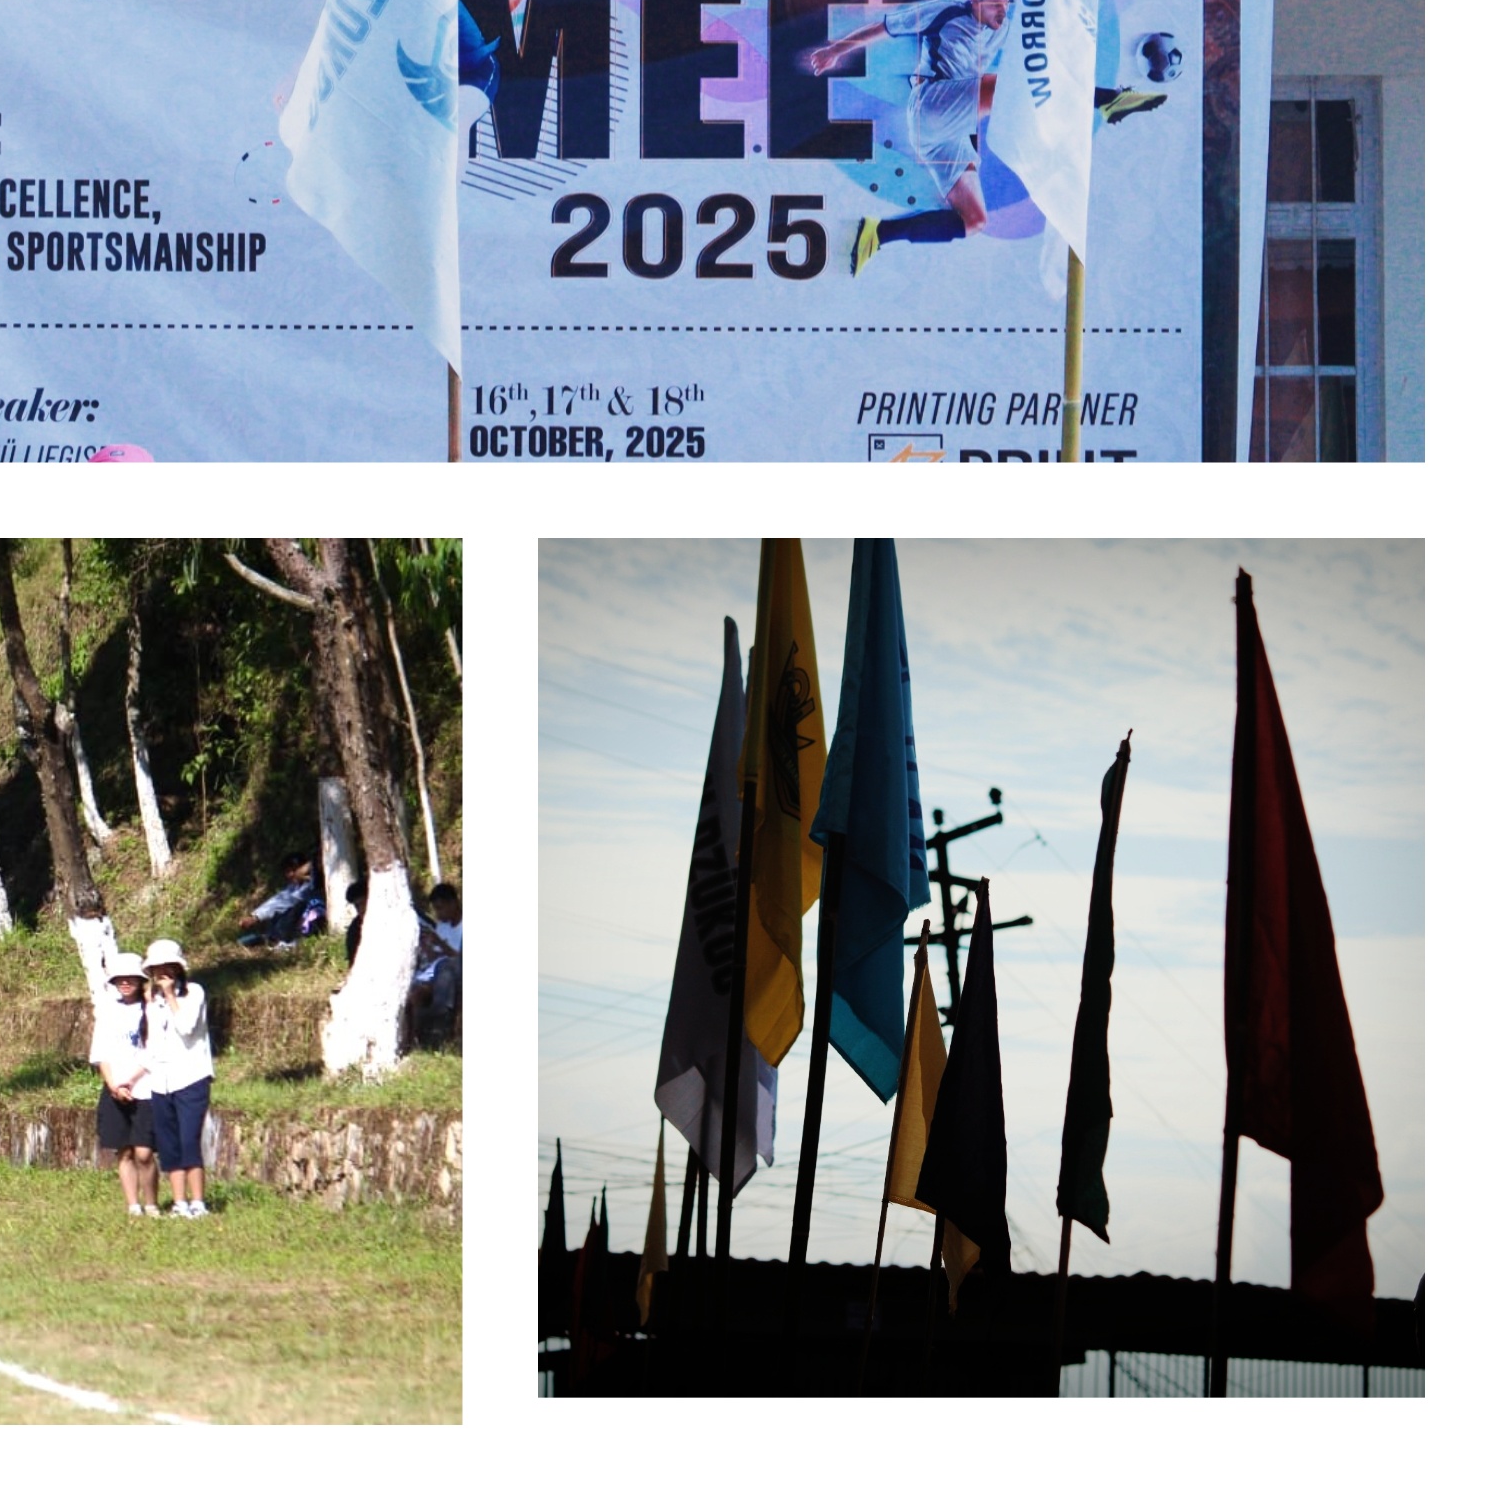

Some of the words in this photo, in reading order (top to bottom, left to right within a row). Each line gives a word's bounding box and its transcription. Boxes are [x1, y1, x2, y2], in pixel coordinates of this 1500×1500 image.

[7, 232, 267, 272] SPORTSMANSHIP
[550, 192, 828, 280] 2025
[607, 385, 634, 417] &
[647, 383, 705, 417] 18th
[857, 392, 997, 425] PRINTING
[1005, 392, 1138, 426] PARNER
[470, 424, 614, 462] OCTOBER,
[626, 425, 706, 459] 2025
